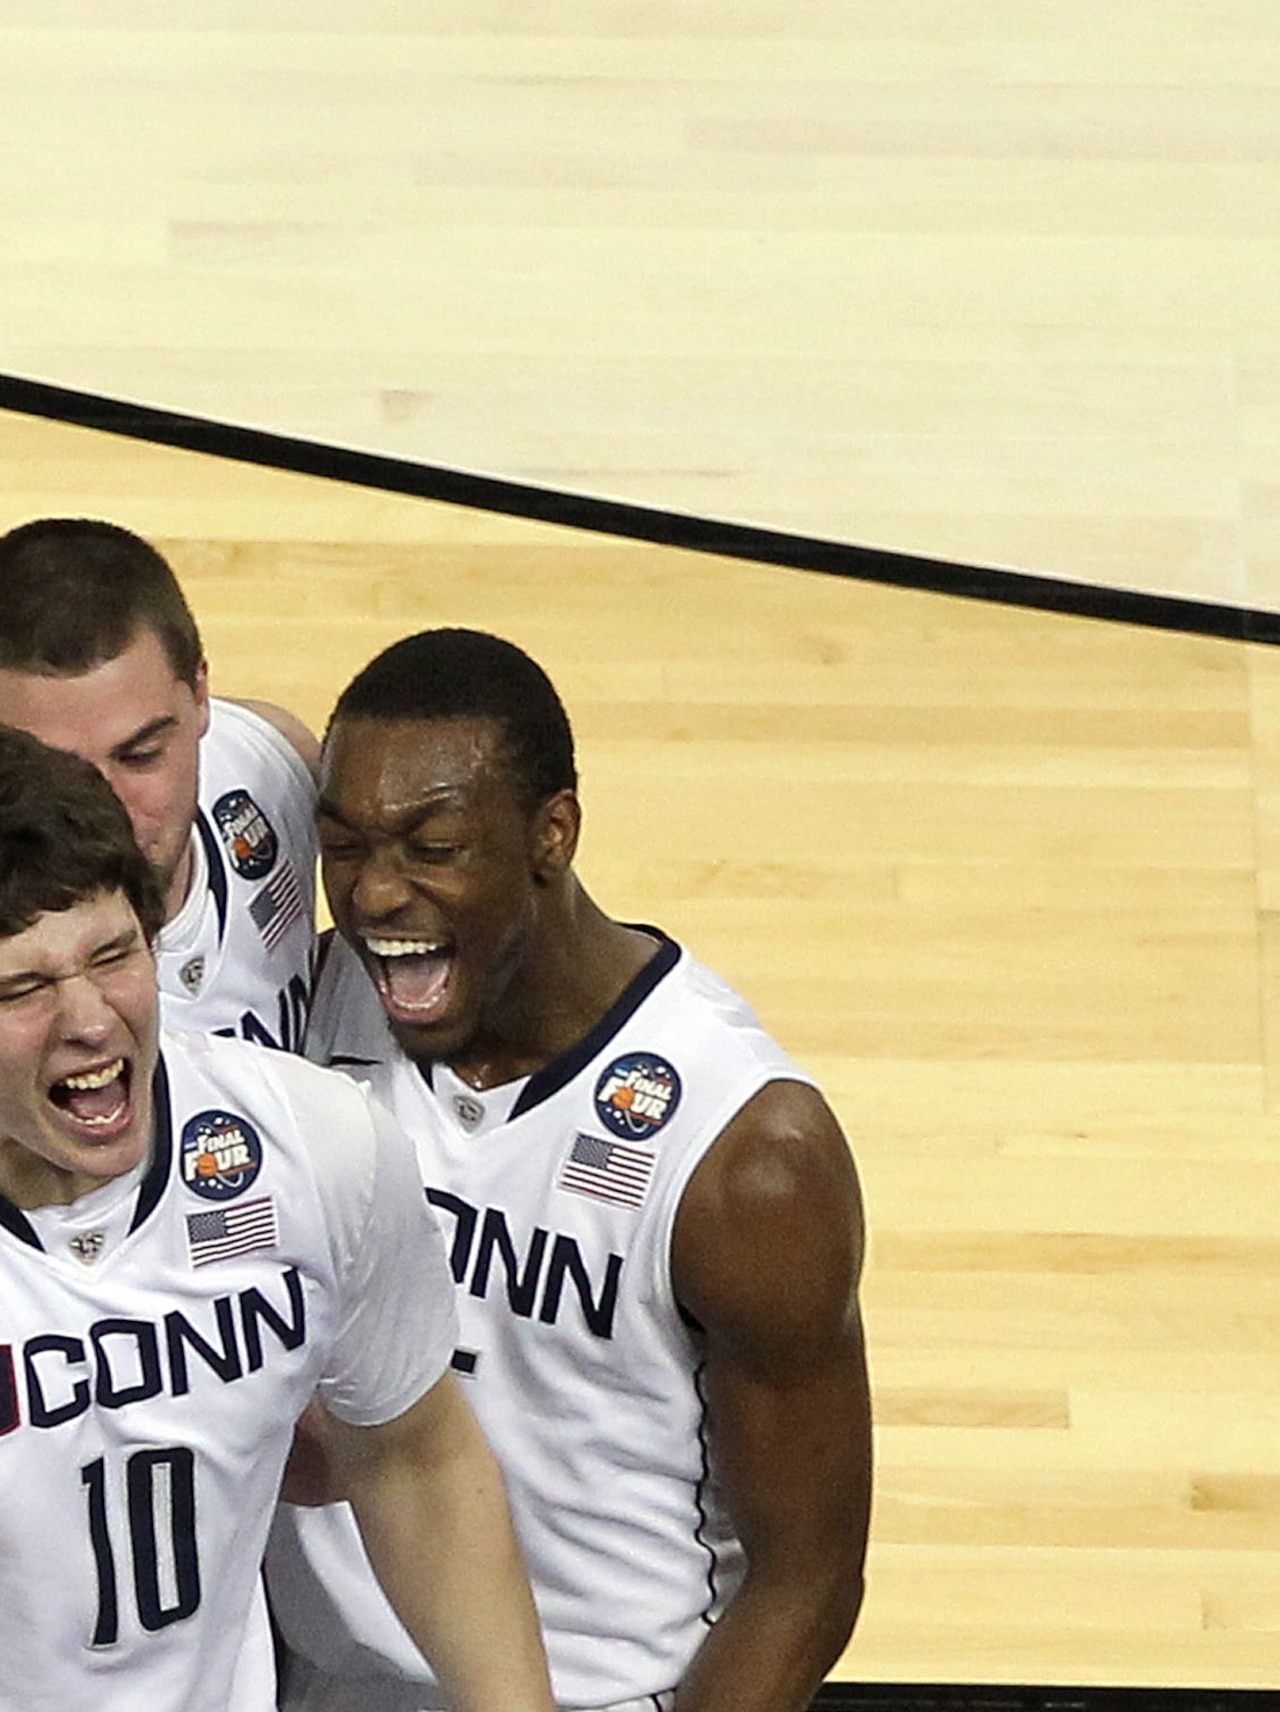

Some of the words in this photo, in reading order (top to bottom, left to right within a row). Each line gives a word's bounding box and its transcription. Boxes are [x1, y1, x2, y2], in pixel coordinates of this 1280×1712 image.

[598, 1076, 668, 1120] FOUR
[625, 1070, 673, 1101] FINAL
[197, 1129, 245, 1155] FINAL
[184, 1144, 251, 1181] FOUR
[81, 1446, 203, 1648] 10
